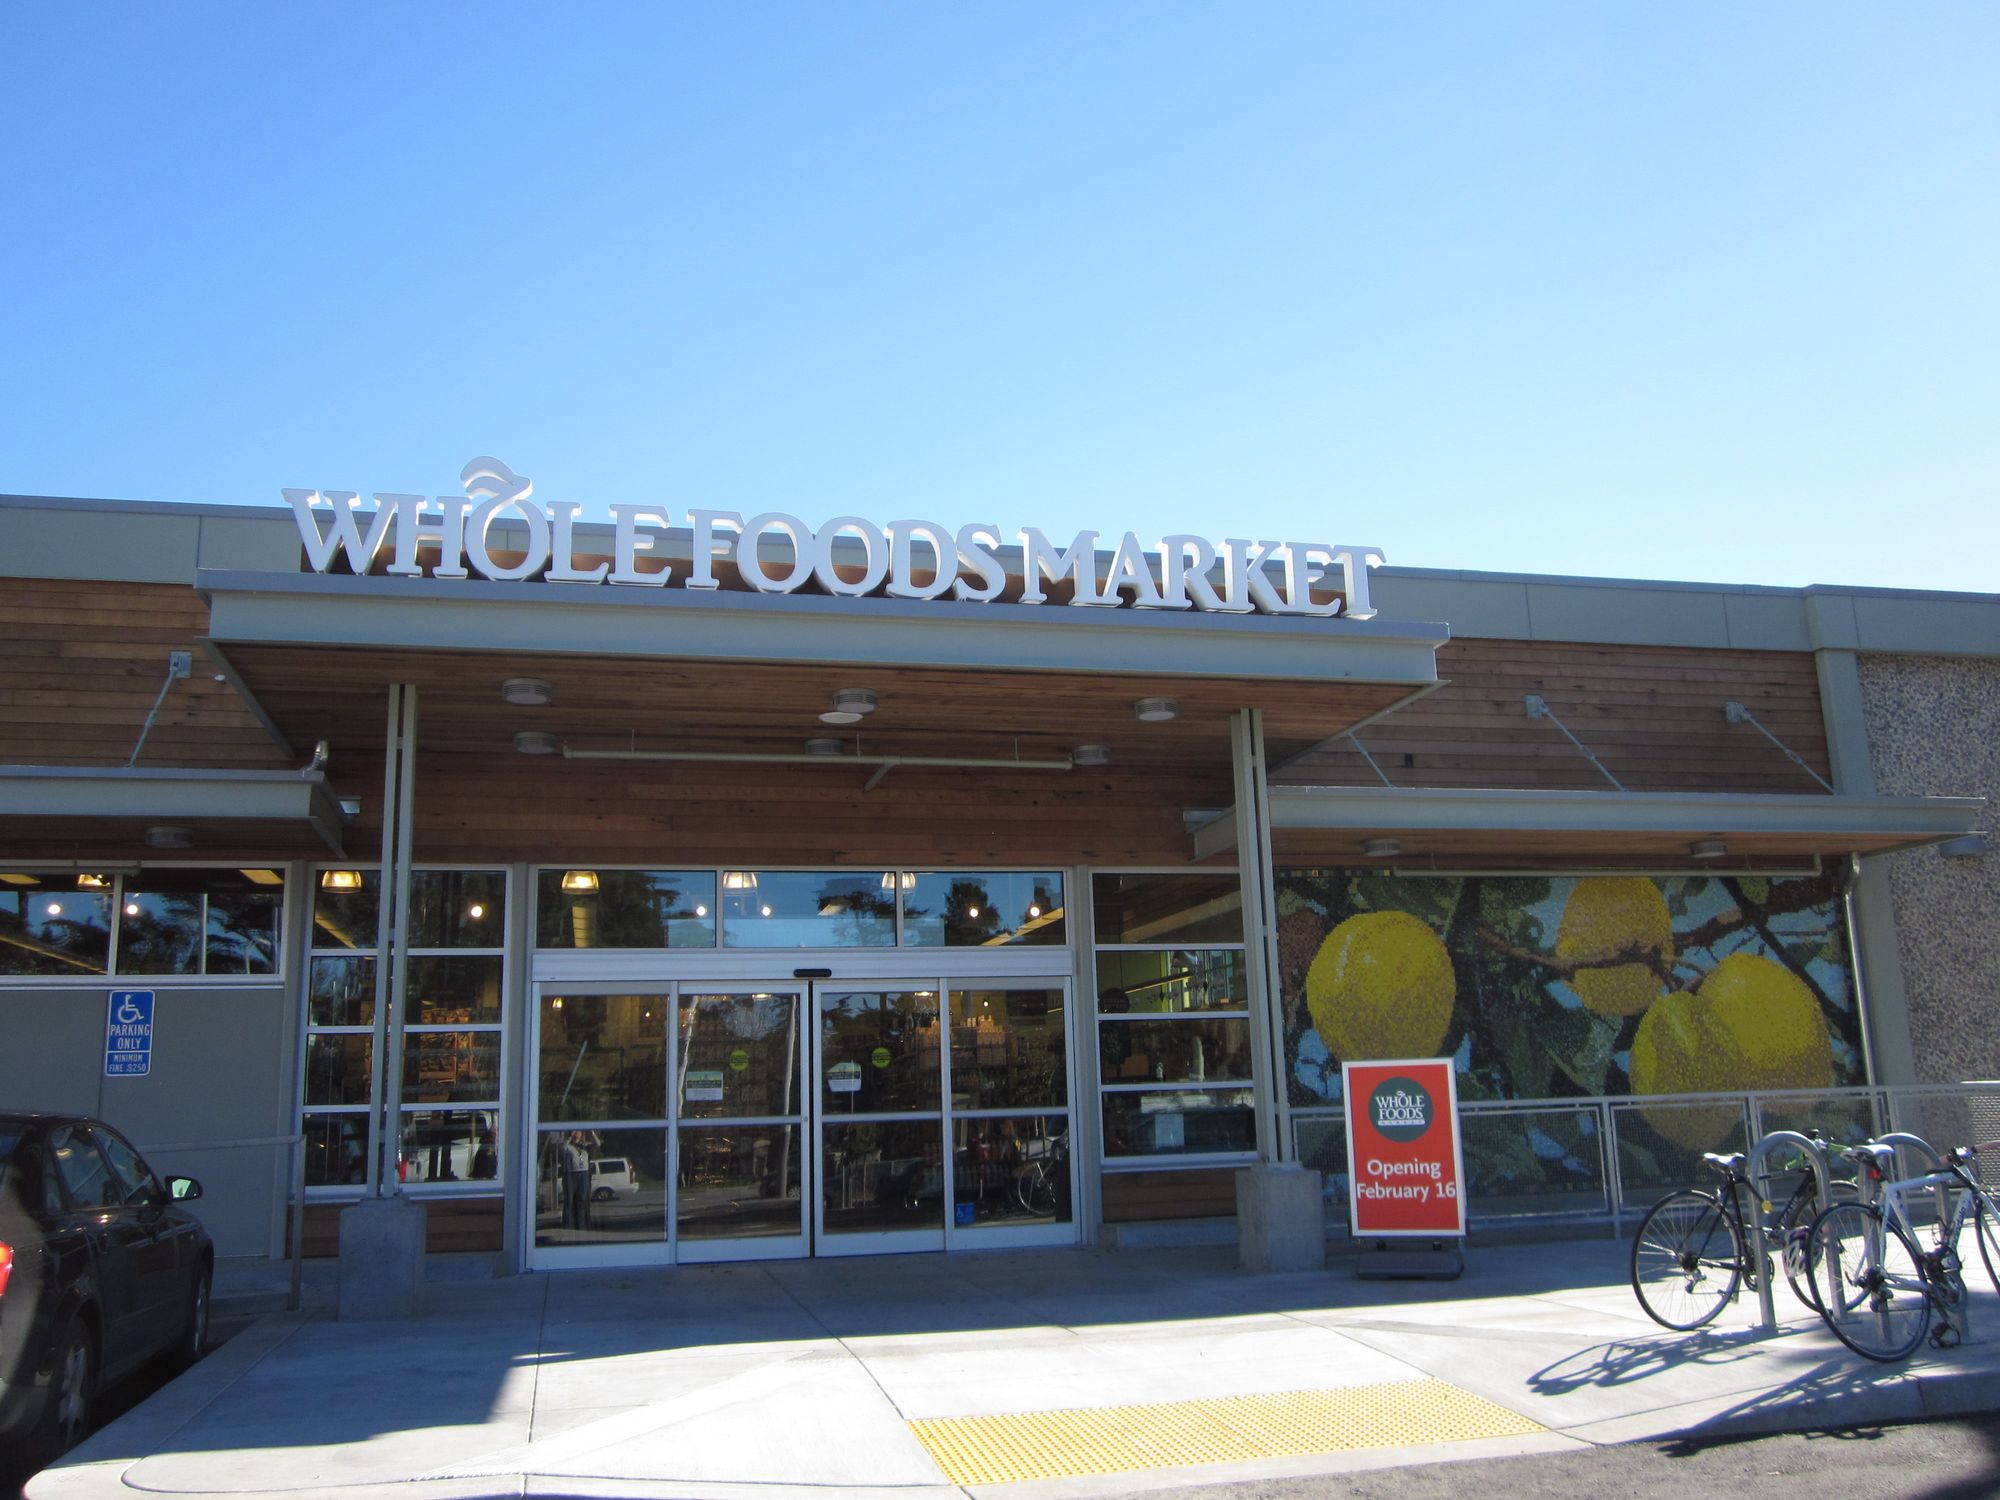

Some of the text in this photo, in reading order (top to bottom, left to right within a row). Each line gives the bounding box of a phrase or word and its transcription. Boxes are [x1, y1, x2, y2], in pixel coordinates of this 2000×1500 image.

[282, 456, 1387, 621] WHOLE FOODS MARKET
[110, 1024, 150, 1036] PARKING
[118, 1038, 142, 1050] ONLY
[114, 1054, 142, 1062] MINIMUM
[108, 1064, 146, 1072] FINE $250
[1376, 1090, 1424, 1108] WHOLE
[1379, 1108, 1424, 1120] FOODS
[1367, 1158, 1441, 1179] Opening
[1356, 1182, 1457, 1202] February 16
